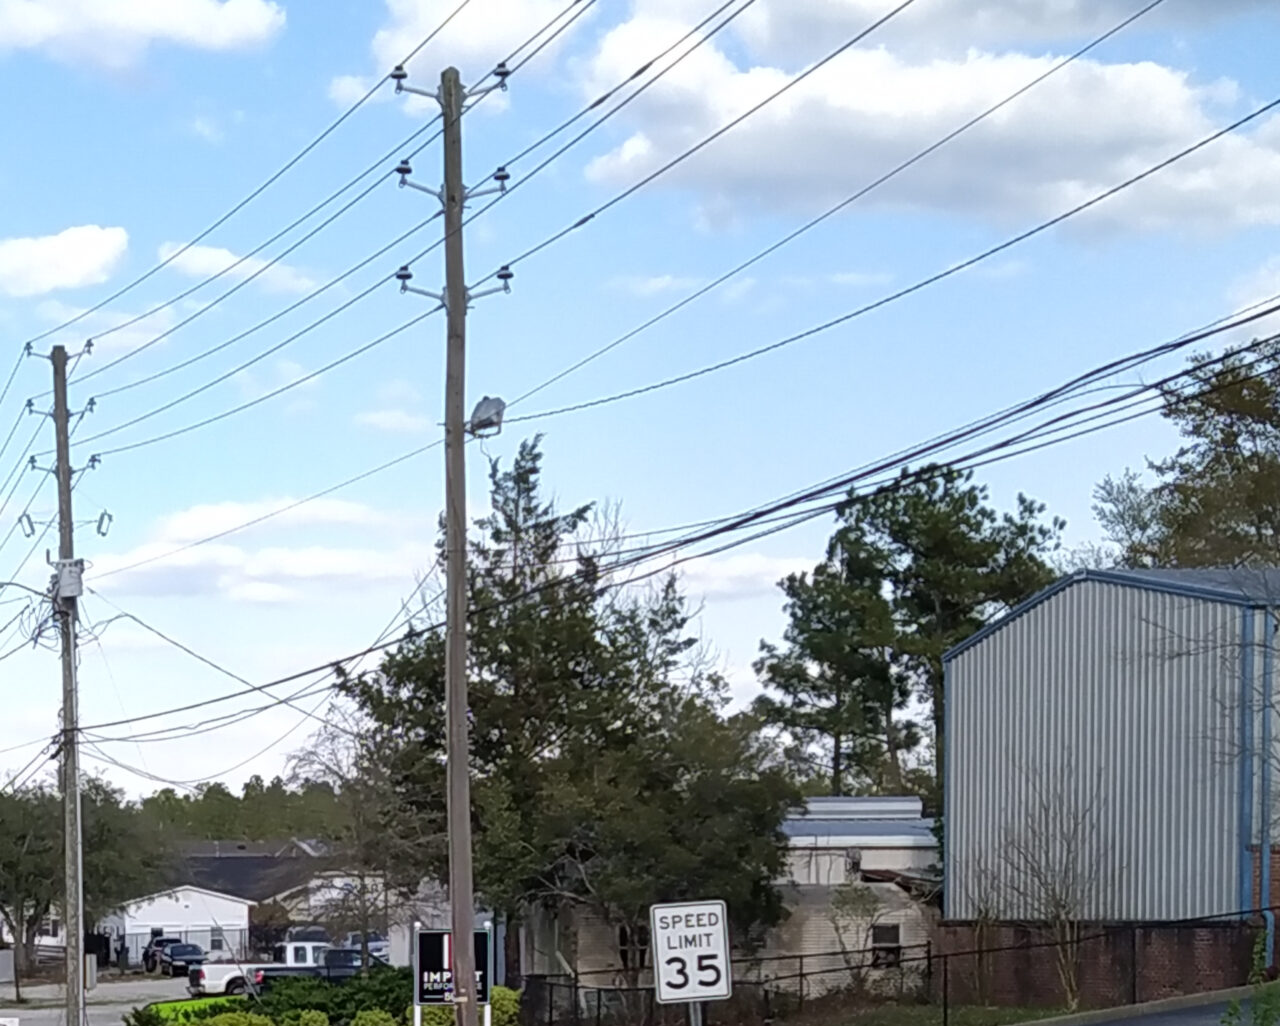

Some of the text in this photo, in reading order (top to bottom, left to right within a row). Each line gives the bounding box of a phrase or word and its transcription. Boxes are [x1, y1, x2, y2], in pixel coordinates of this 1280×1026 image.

[659, 912, 719, 930] SPEED
[666, 933, 713, 950] LIMIT
[423, 970, 483, 983] IMPT
[665, 953, 722, 990] 35
